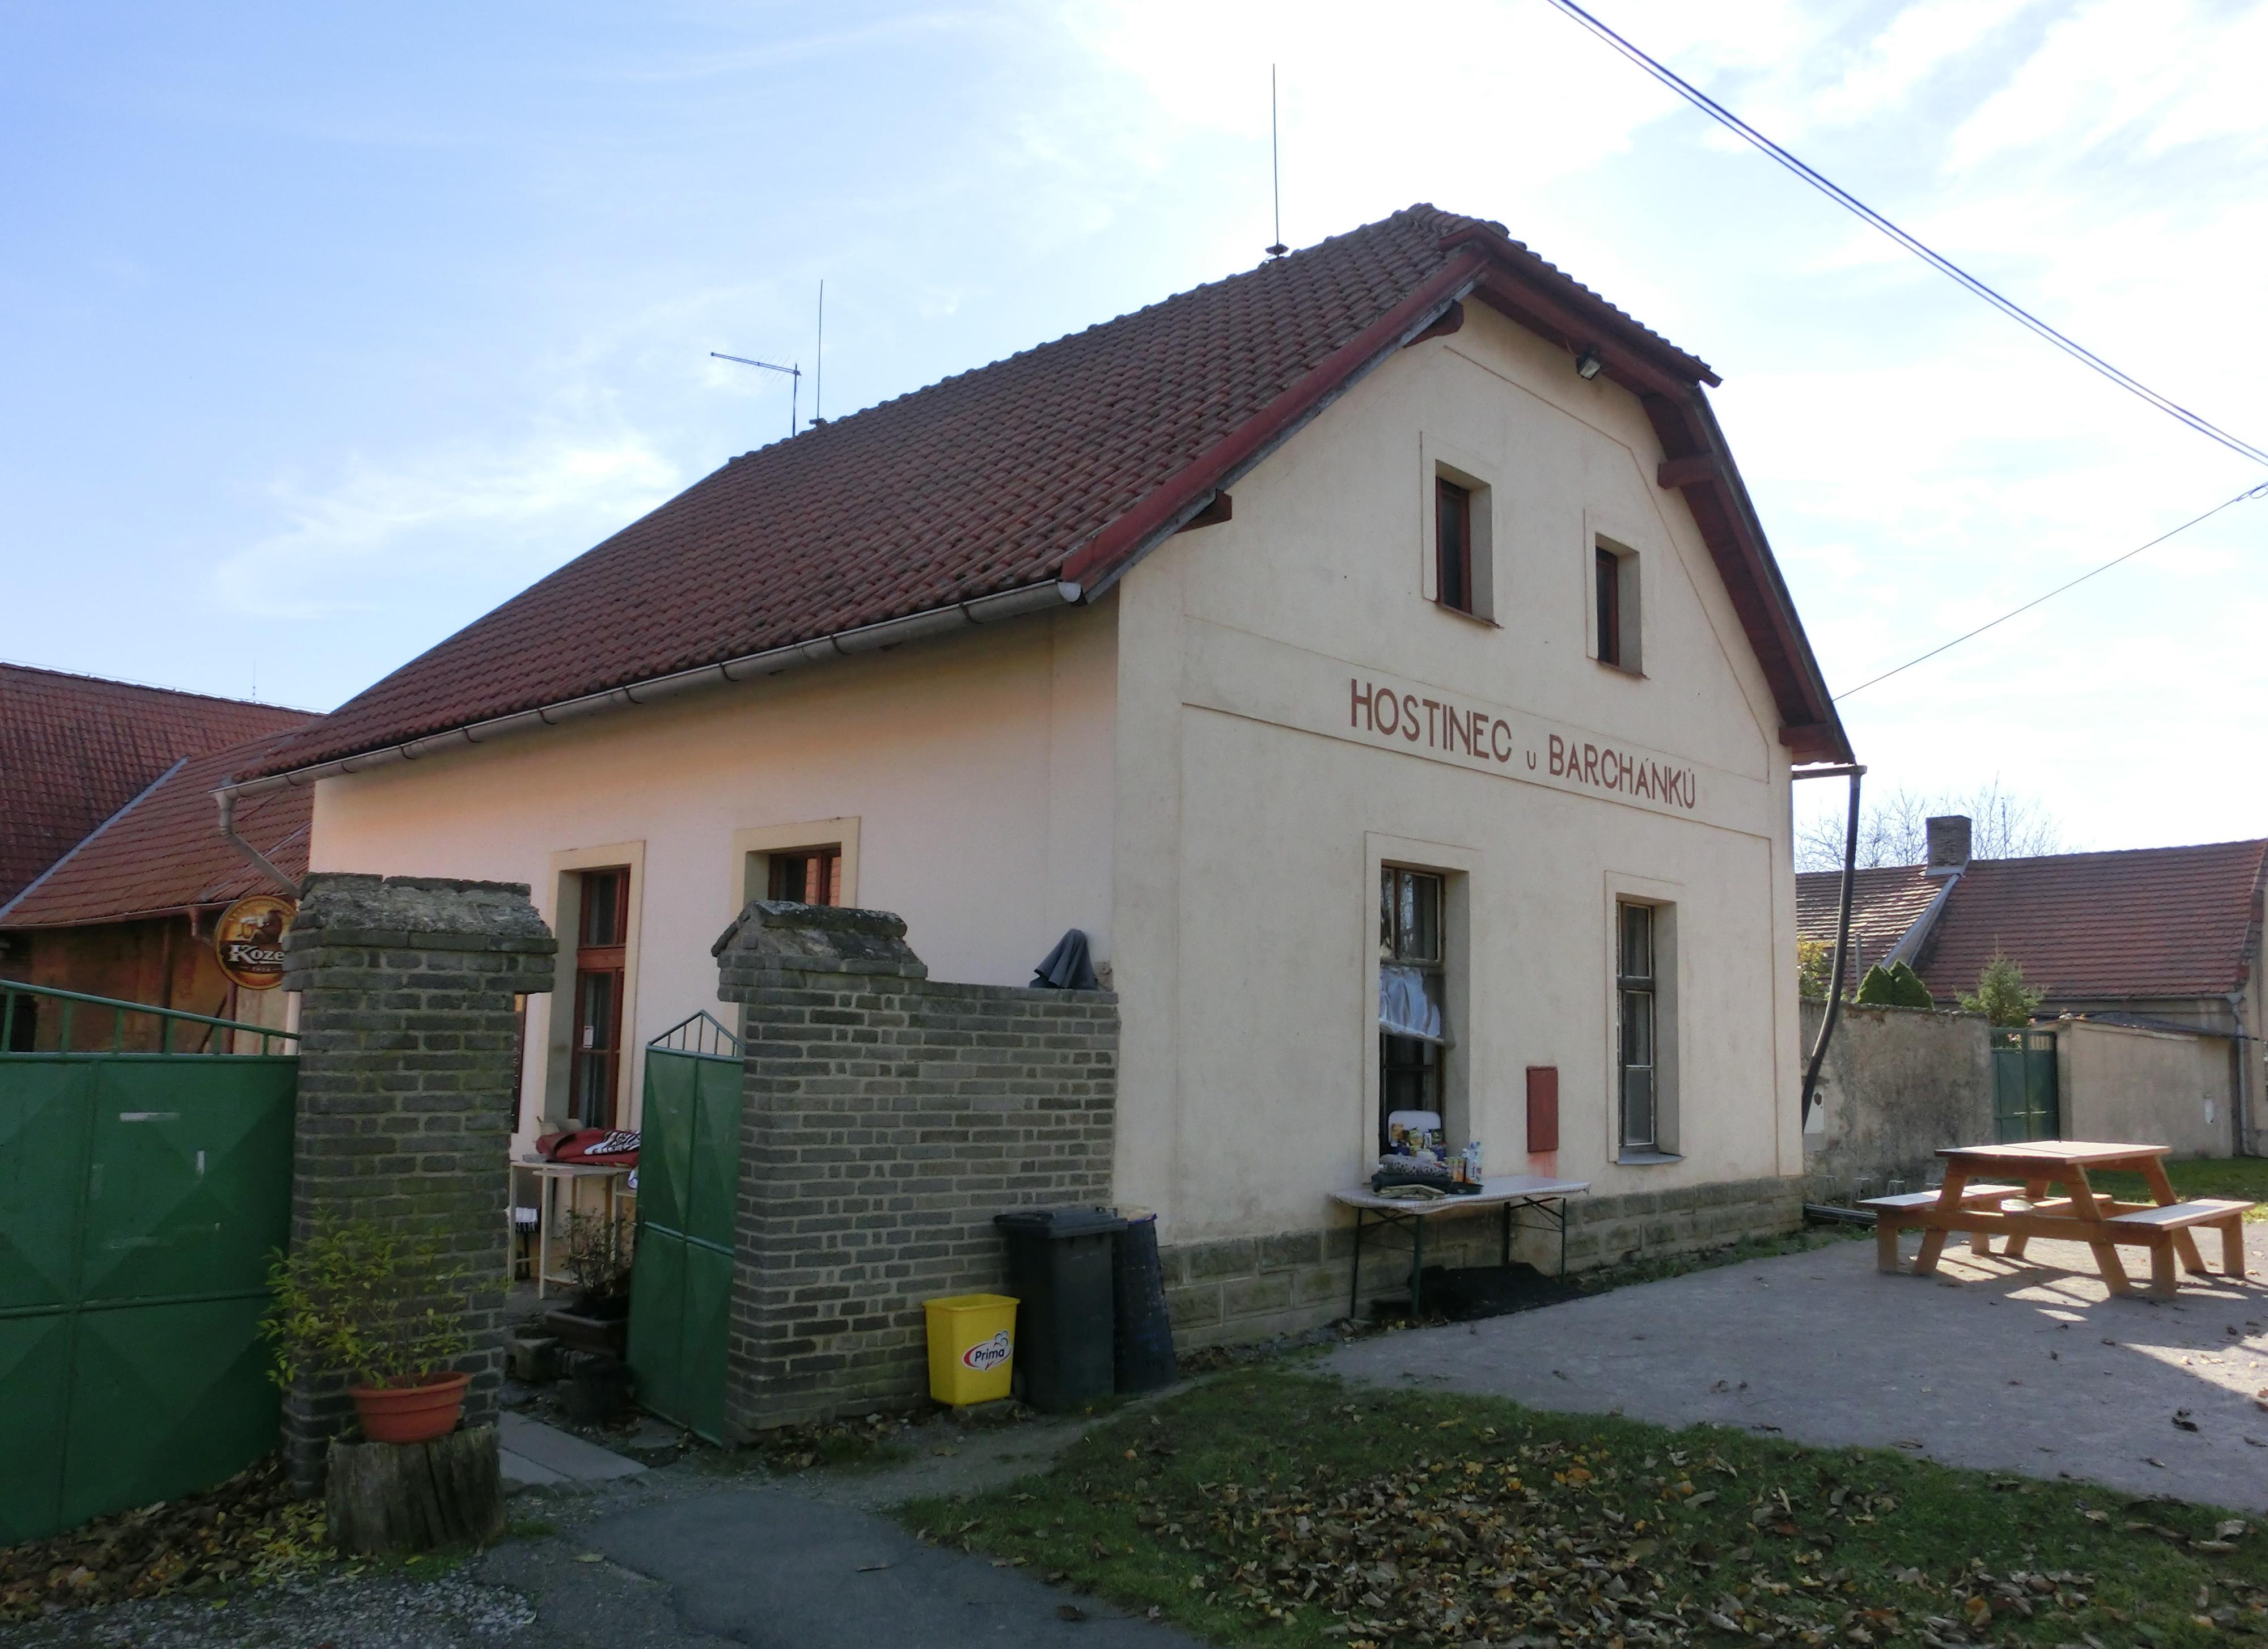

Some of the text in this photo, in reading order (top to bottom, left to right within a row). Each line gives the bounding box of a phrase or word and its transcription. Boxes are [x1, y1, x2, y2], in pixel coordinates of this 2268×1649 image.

[1351, 679, 1512, 762] HOSTINEC
[228, 944, 285, 964] Koze
[975, 1348, 1005, 1362] Prima
